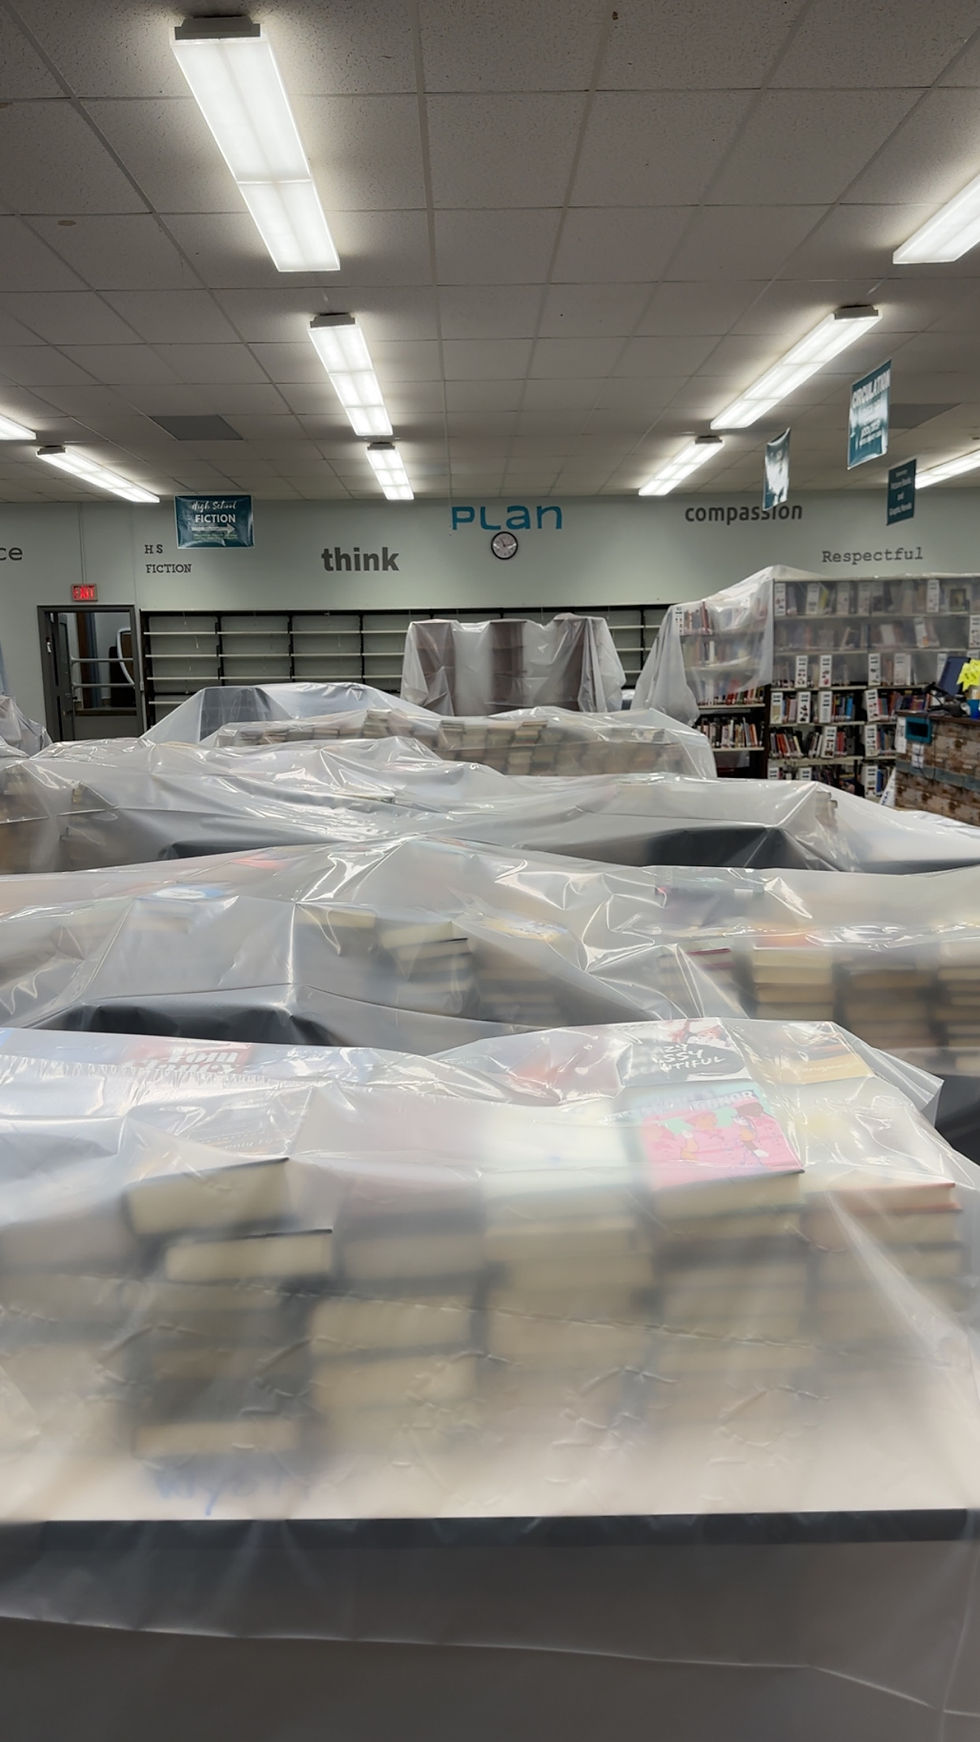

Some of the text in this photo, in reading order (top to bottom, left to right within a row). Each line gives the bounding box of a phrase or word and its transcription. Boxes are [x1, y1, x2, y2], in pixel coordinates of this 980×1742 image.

[192, 501, 237, 512] High School
[195, 514, 236, 523] FICTION
[685, 504, 803, 525] compassion
[321, 547, 399, 571] think
[822, 547, 923, 565] Respectful
[145, 564, 192, 573] FICTION
[73, 585, 96, 600] EXIT
